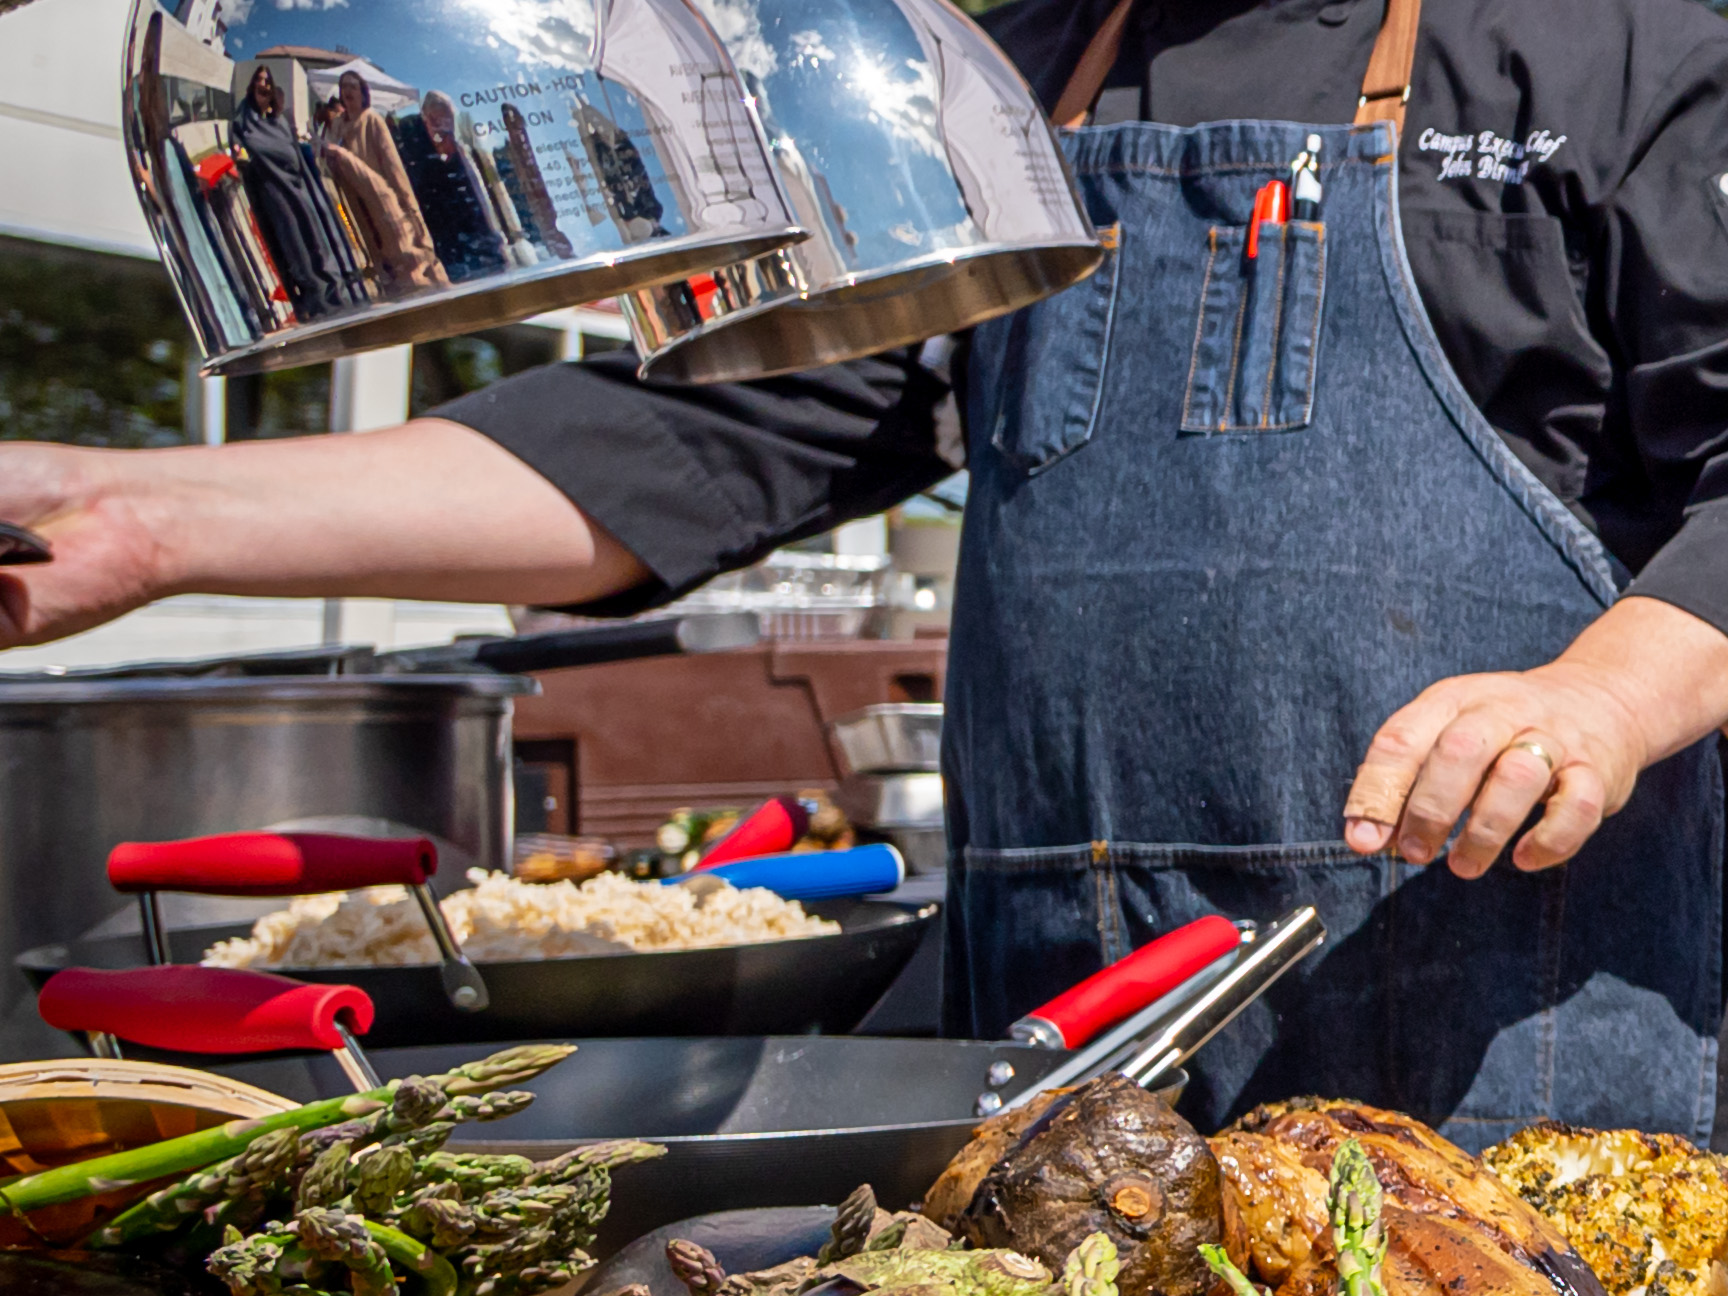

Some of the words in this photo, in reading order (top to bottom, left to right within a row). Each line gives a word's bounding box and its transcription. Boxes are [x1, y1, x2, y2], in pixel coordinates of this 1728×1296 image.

[460, 82, 542, 108] CAUTION
[552, 74, 586, 92] HOT
[473, 109, 555, 137] CAUON
[1525, 129, 1568, 162] Chef
